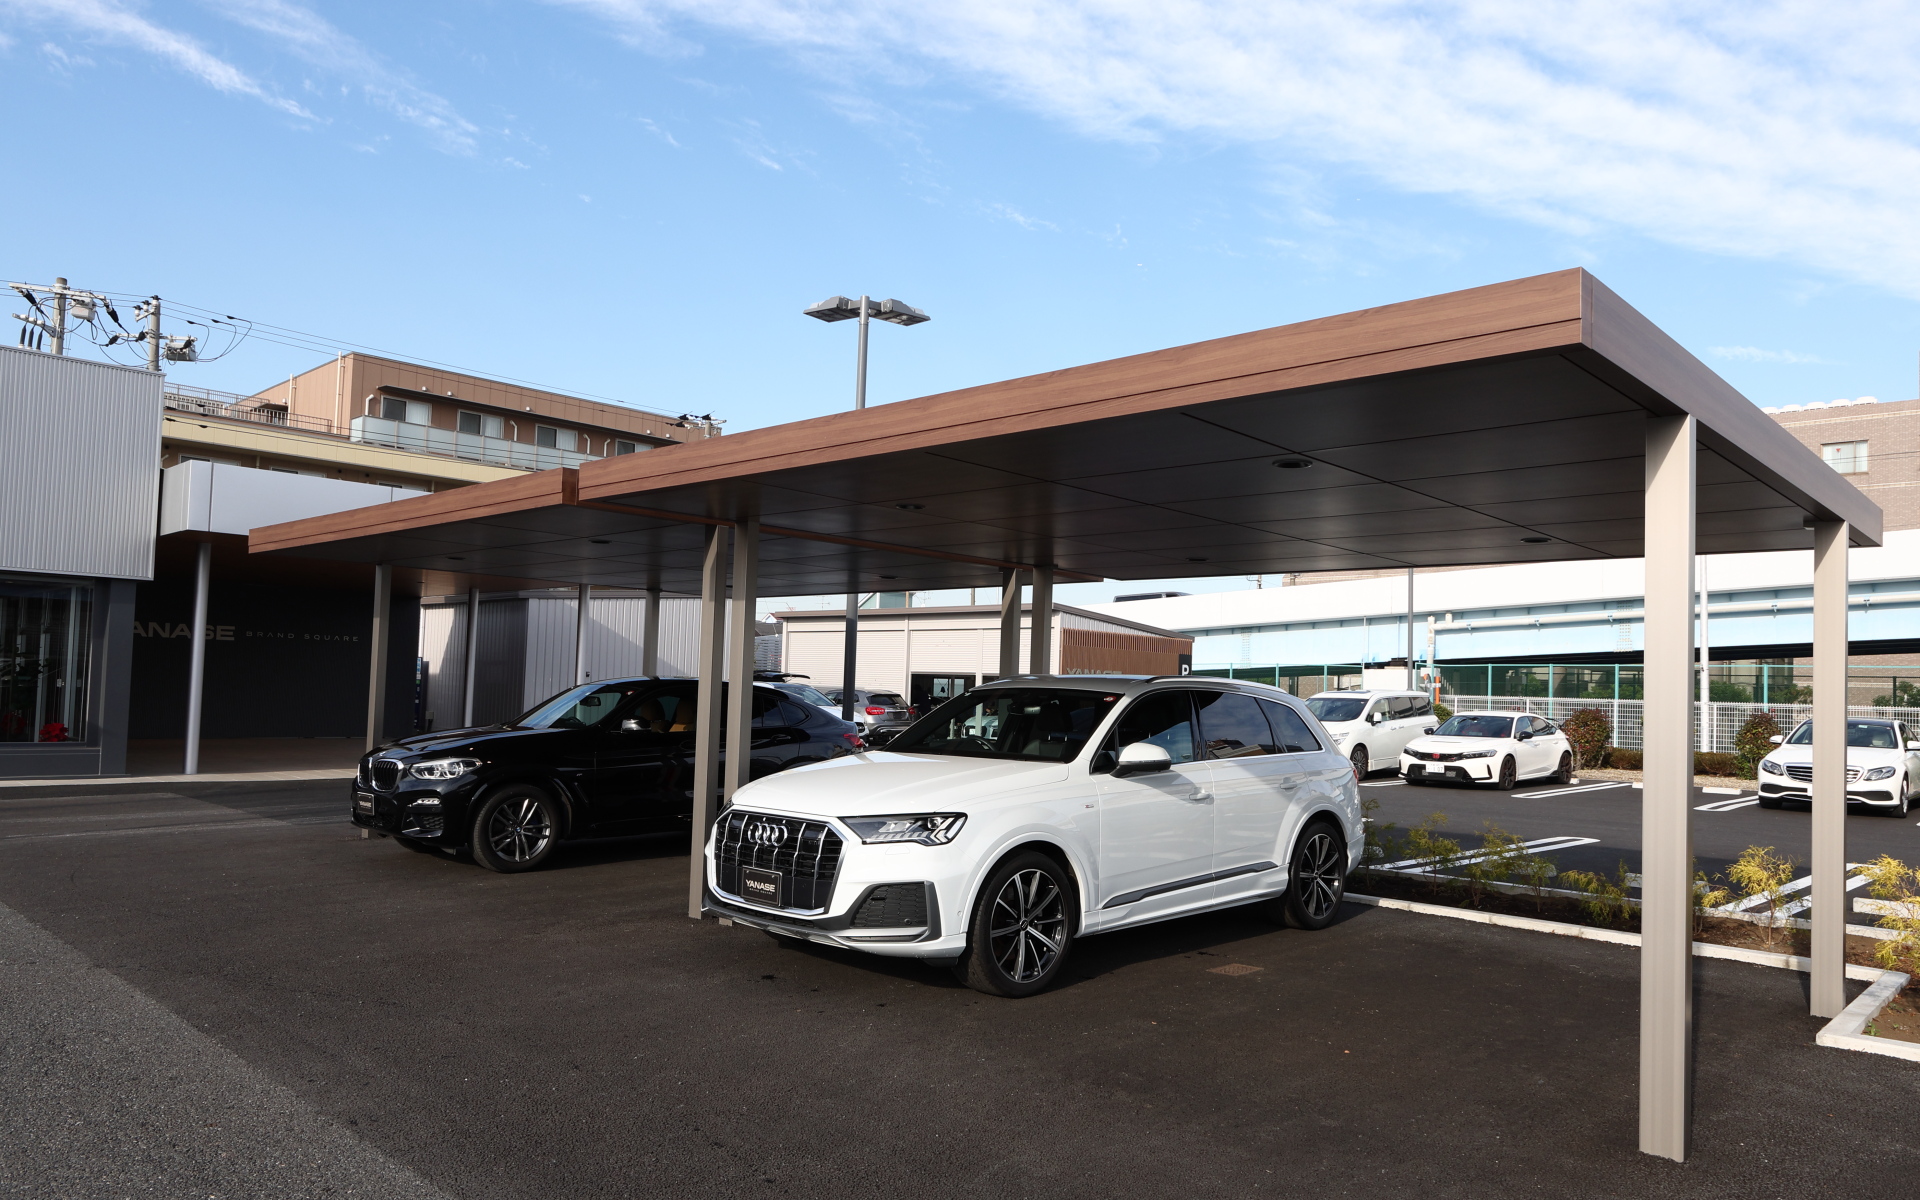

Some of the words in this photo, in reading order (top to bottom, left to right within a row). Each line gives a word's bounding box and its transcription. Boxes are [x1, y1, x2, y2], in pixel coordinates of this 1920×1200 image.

[133, 621, 235, 640] ANAE
[246, 631, 295, 639] BRAND
[304, 634, 359, 642] SQUARE
[1181, 664, 1190, 676] P
[746, 880, 775, 892] YANASE
